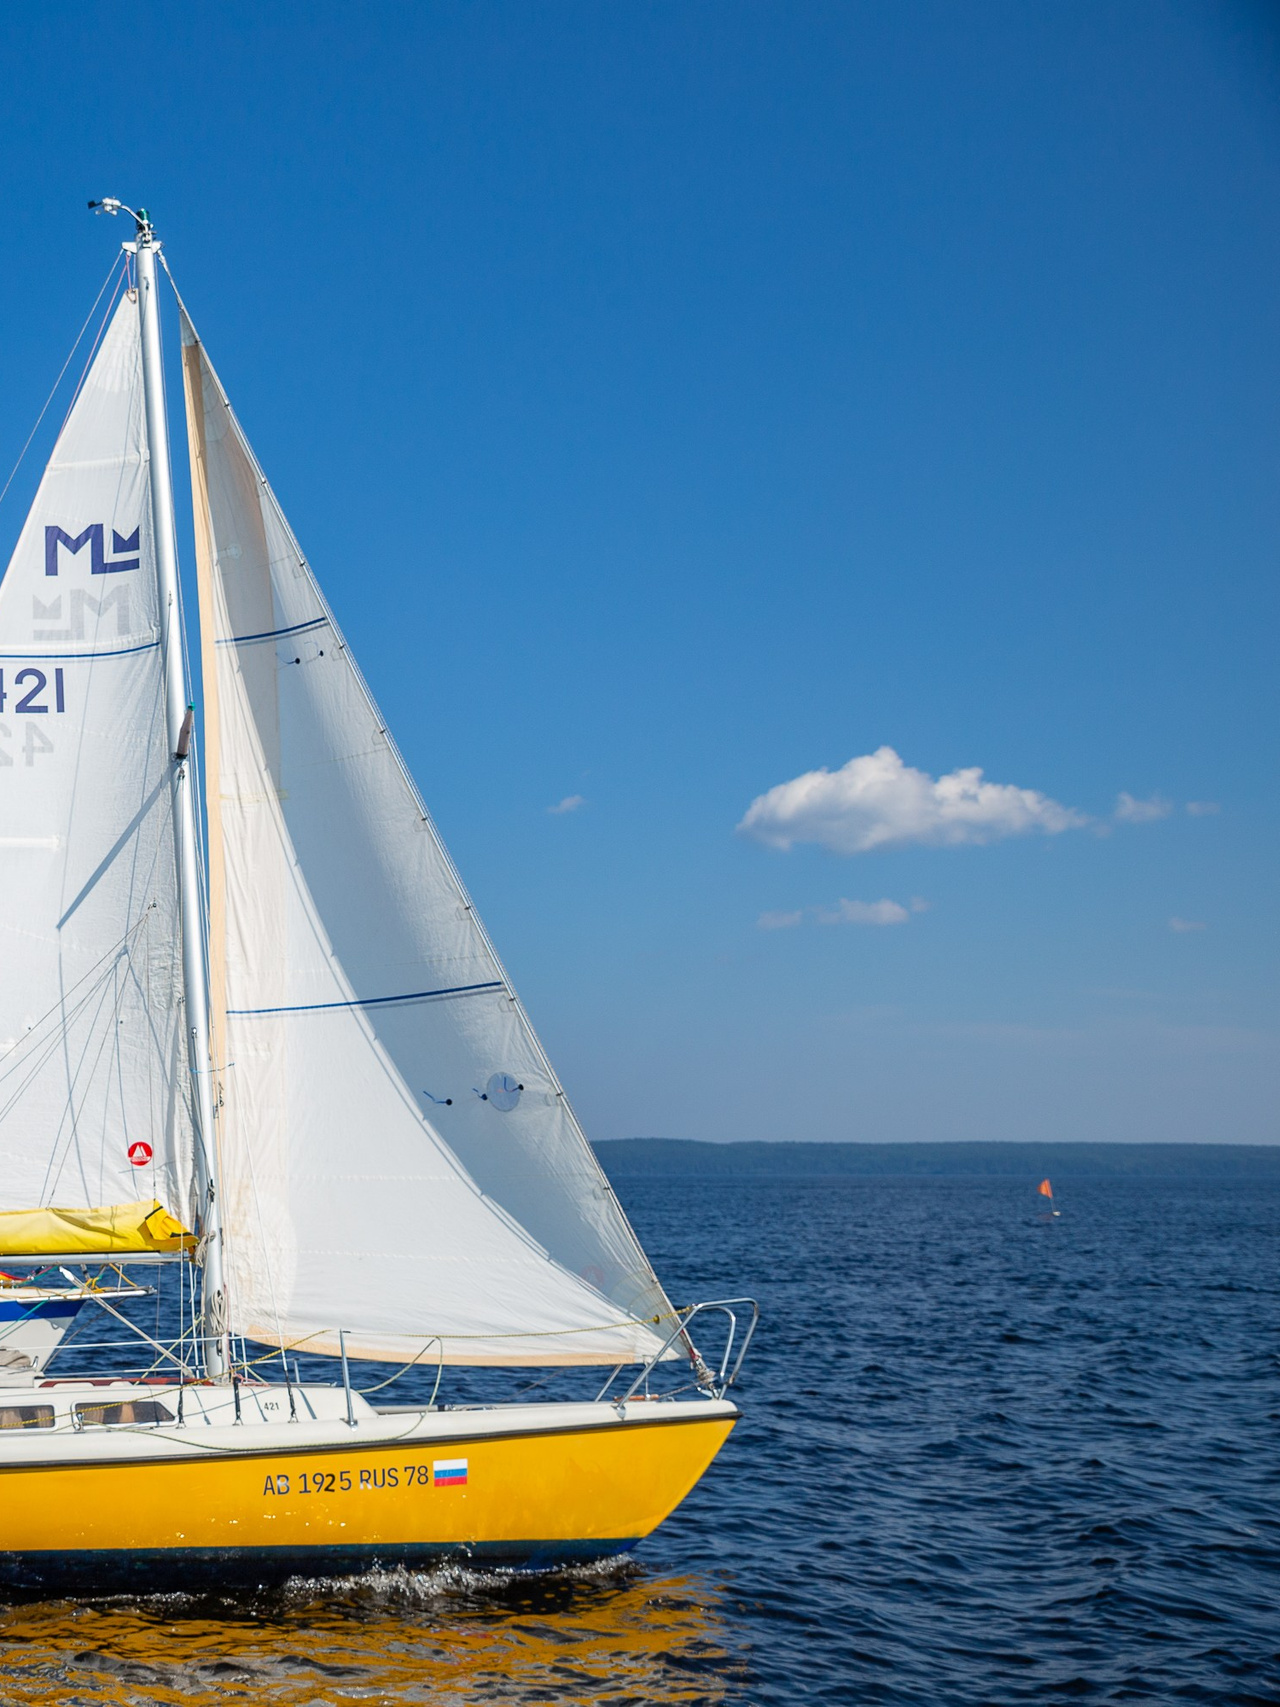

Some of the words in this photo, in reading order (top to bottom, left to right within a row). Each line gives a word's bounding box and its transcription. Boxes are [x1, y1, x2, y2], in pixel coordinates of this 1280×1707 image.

[264, 1402, 280, 1411] 421
[263, 1474, 290, 1496] AB
[298, 1471, 352, 1494] 1925
[359, 1467, 399, 1490] RUS
[404, 1465, 429, 1487] 78
